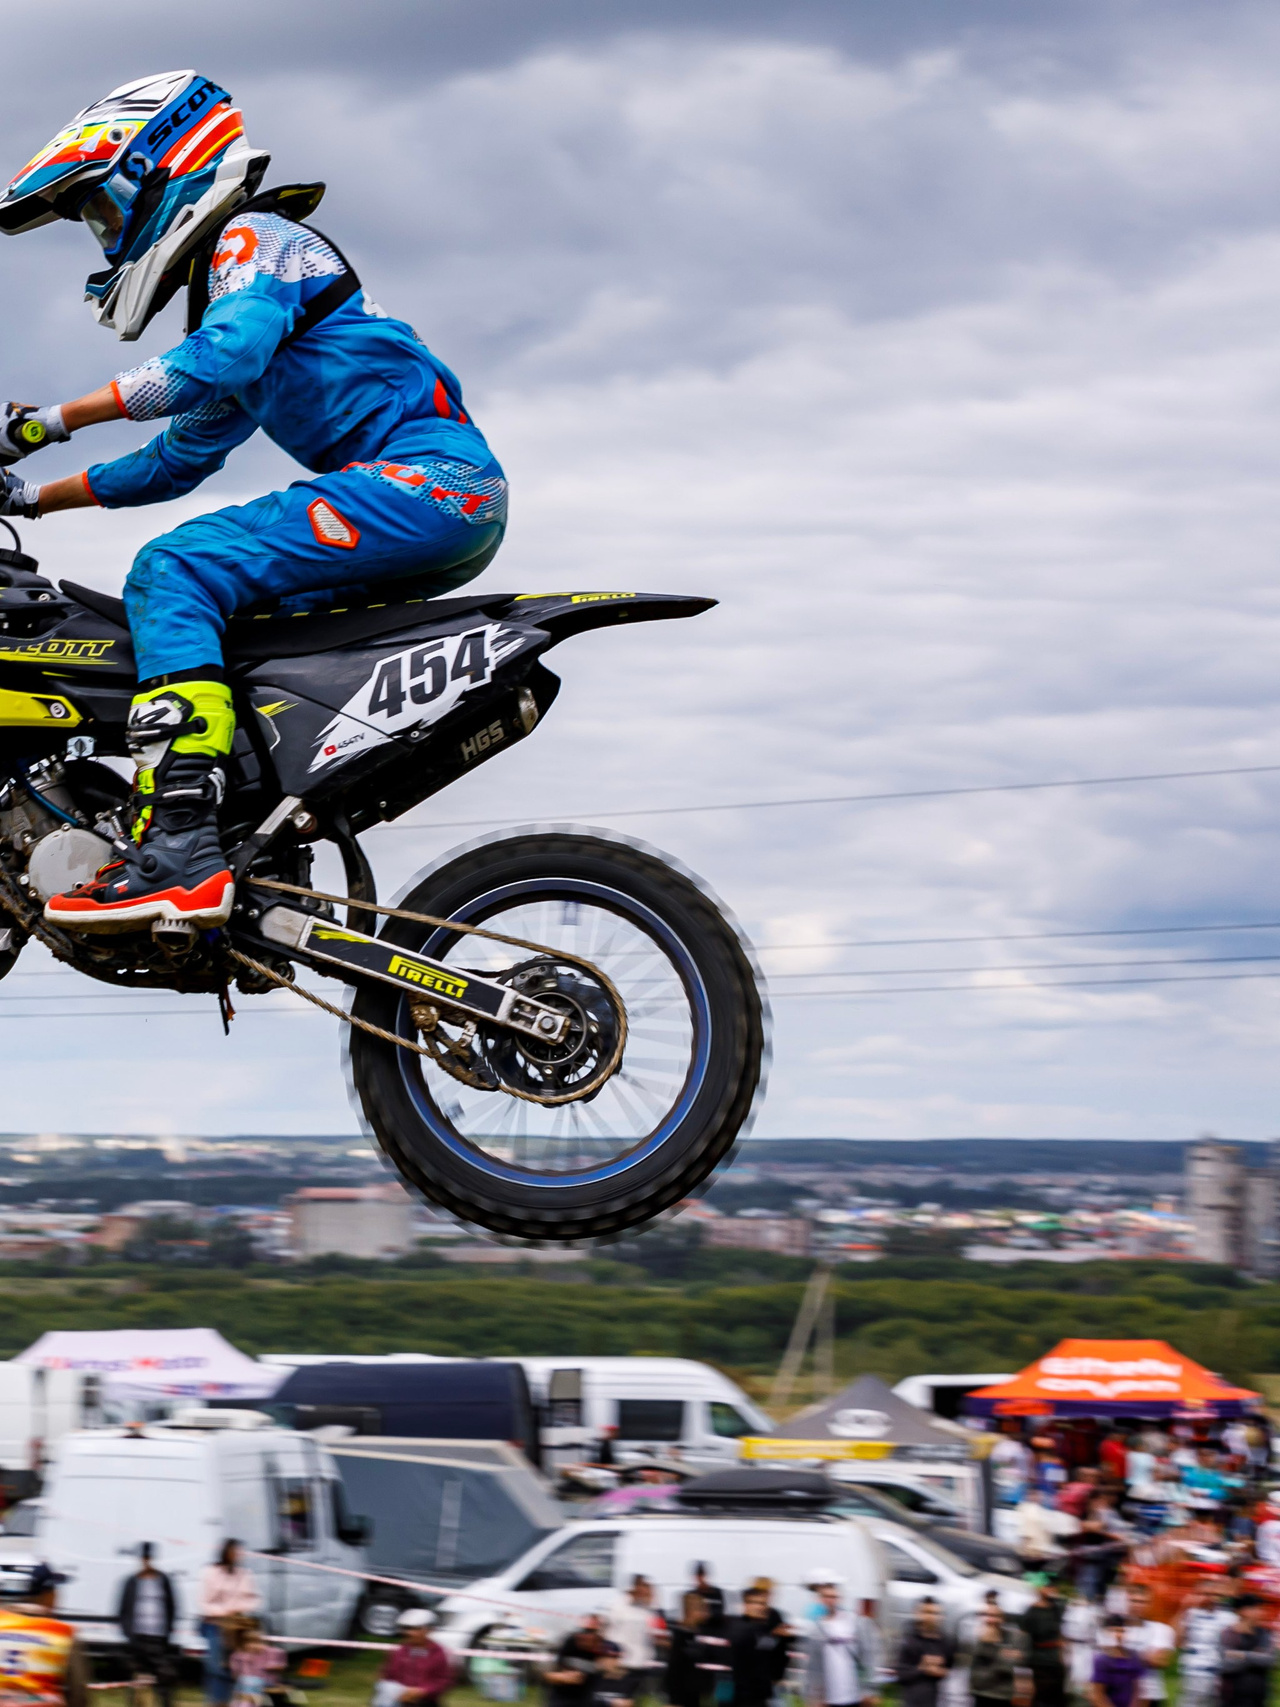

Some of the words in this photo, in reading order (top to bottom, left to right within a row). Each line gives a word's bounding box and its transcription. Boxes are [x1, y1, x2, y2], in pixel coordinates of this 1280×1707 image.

[147, 81, 223, 155] SCOT
[368, 629, 490, 719] 454
[461, 719, 505, 761] HGS
[387, 955, 469, 998] PIRELLI
